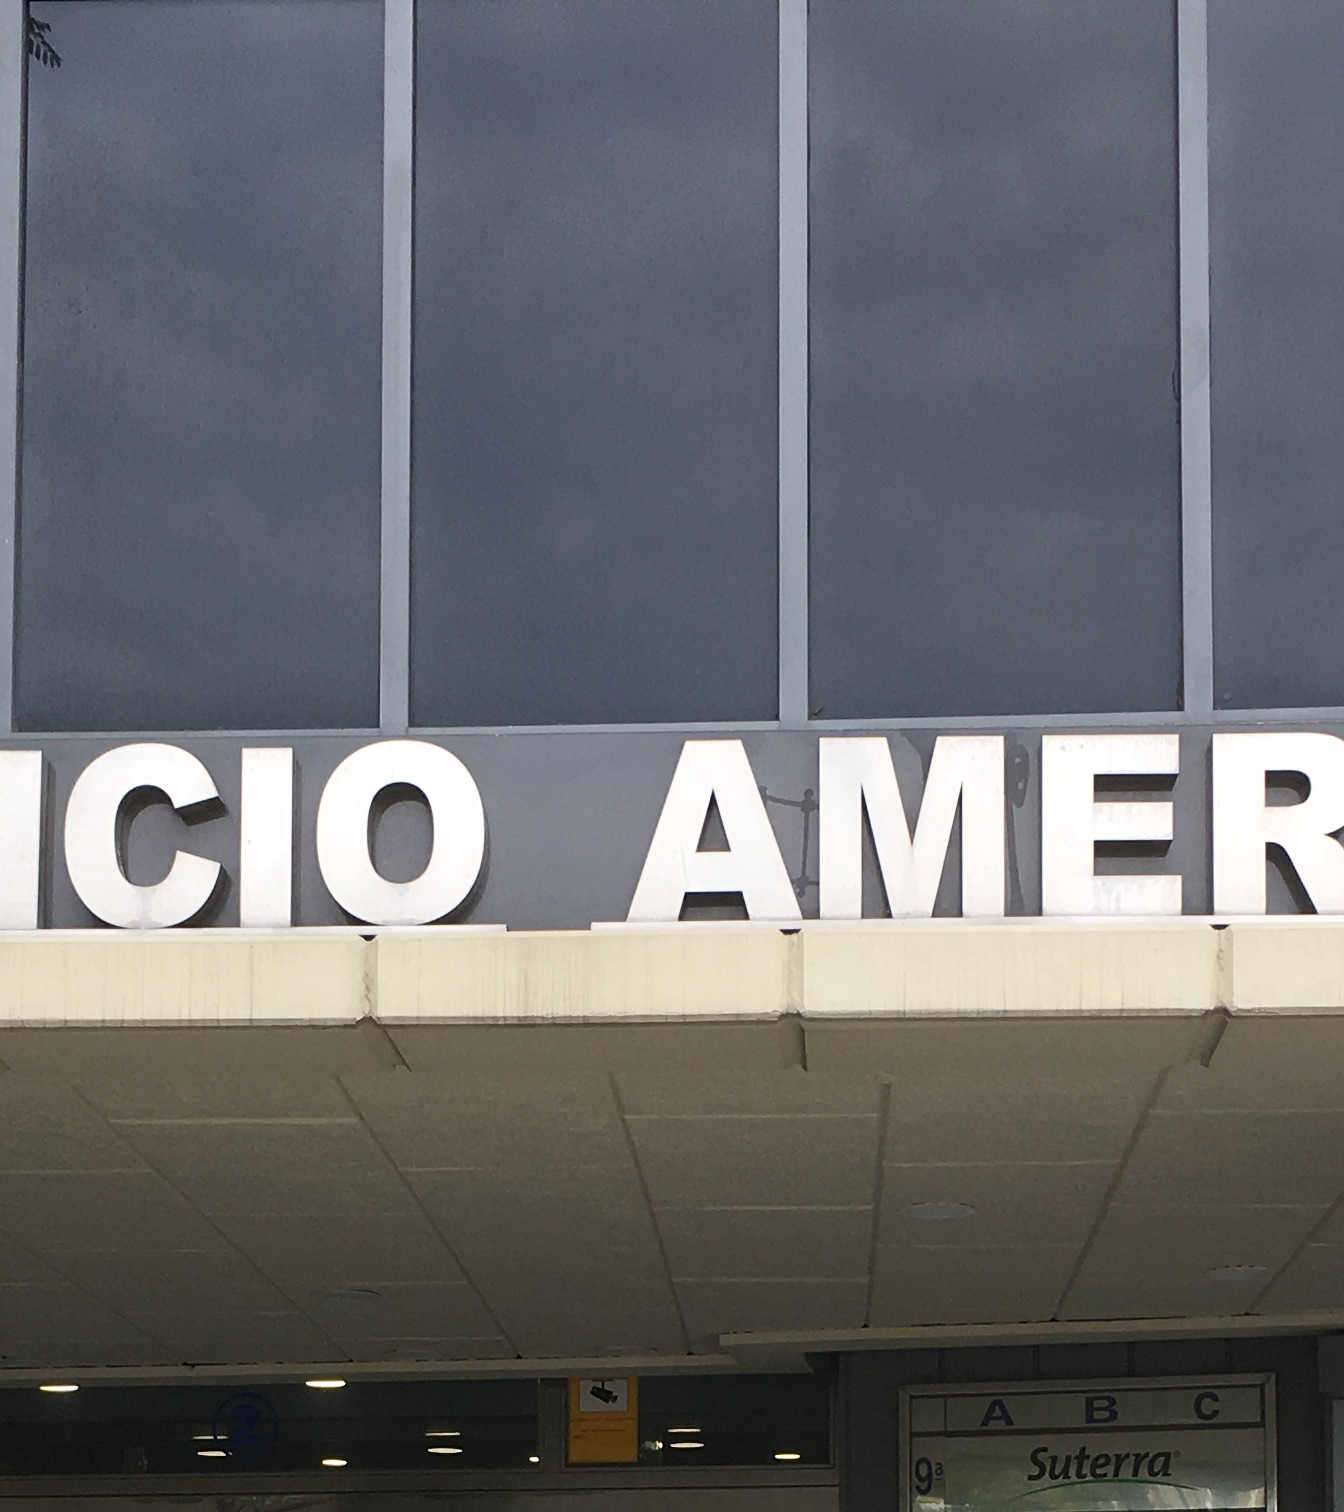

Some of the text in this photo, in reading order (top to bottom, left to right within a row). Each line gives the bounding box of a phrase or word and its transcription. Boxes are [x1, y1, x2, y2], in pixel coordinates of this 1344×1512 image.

[980, 1391, 1220, 1427] A B C
